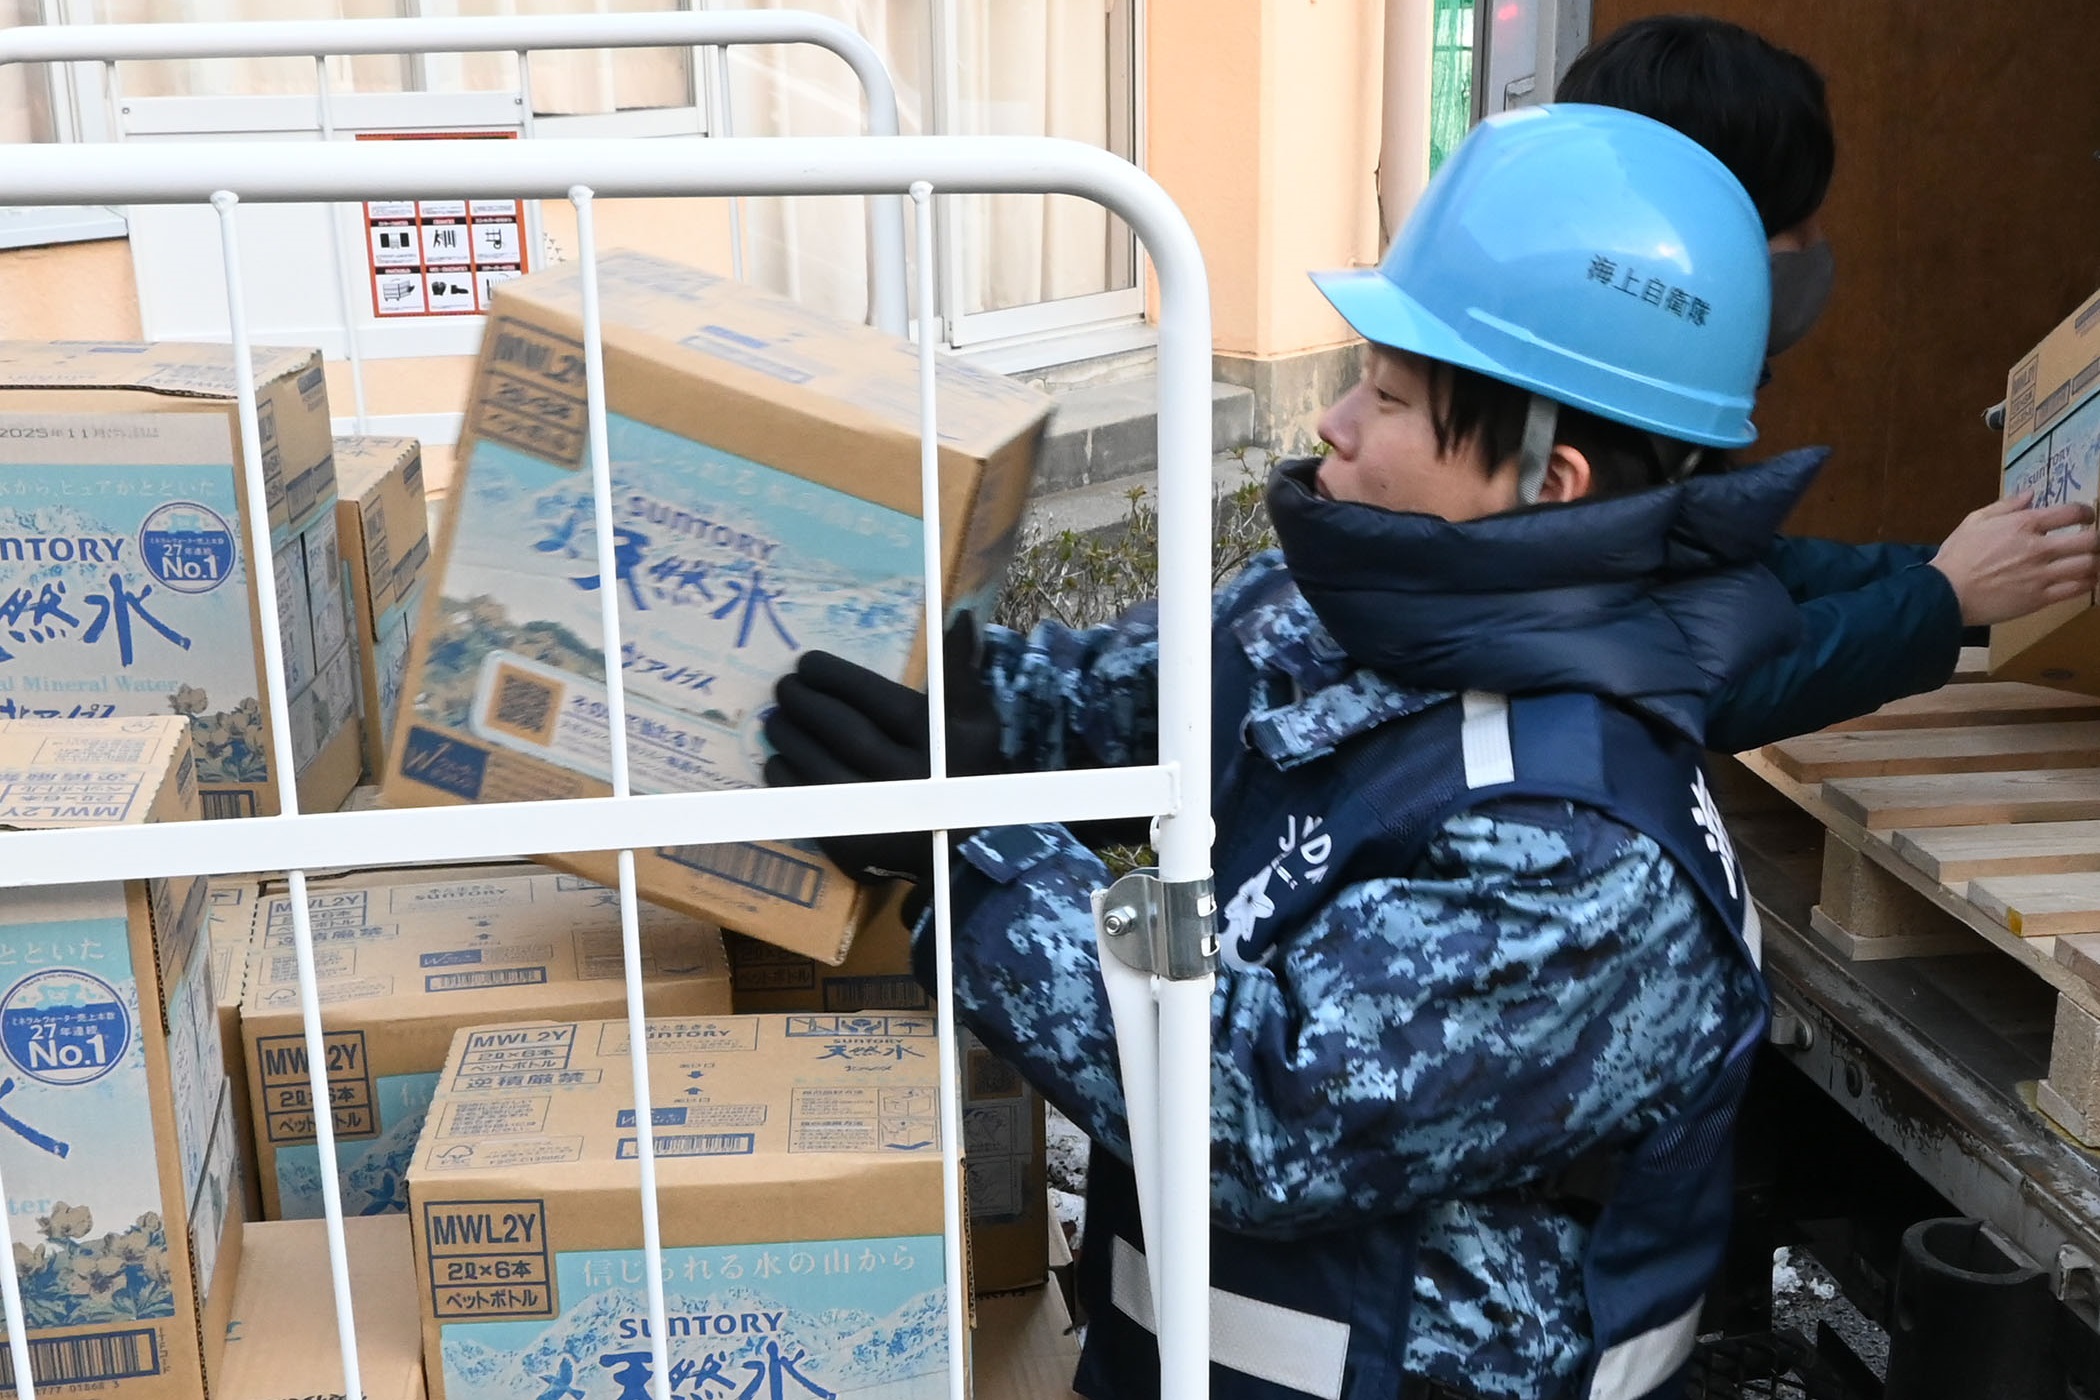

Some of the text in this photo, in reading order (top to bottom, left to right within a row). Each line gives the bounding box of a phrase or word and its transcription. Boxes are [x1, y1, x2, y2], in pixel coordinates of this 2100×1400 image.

[1586, 253, 1711, 327] 海上自衛隊
[629, 496, 779, 561] SUNTORY
[162, 554, 219, 579] No.1
[0, 572, 191, 668] 然水
[22, 675, 108, 692] Mineral
[115, 675, 178, 692] Water
[1, 806, 121, 818] MWL2Y
[473, 1029, 568, 1048] MWL2Y
[629, 1029, 731, 1040] NTORY
[28, 1033, 107, 1069] No.1
[265, 1043, 358, 1077] MW2Y
[815, 1044, 926, 1060] 天然水
[471, 1060, 557, 1072] ペットボトル
[279, 1111, 362, 1133] ペットトル
[8, 1197, 51, 1216] ter
[432, 1213, 536, 1245] MWL2Y
[583, 1244, 916, 1286] 信じられる水の山から
[446, 1288, 539, 1309] ペットボトル
